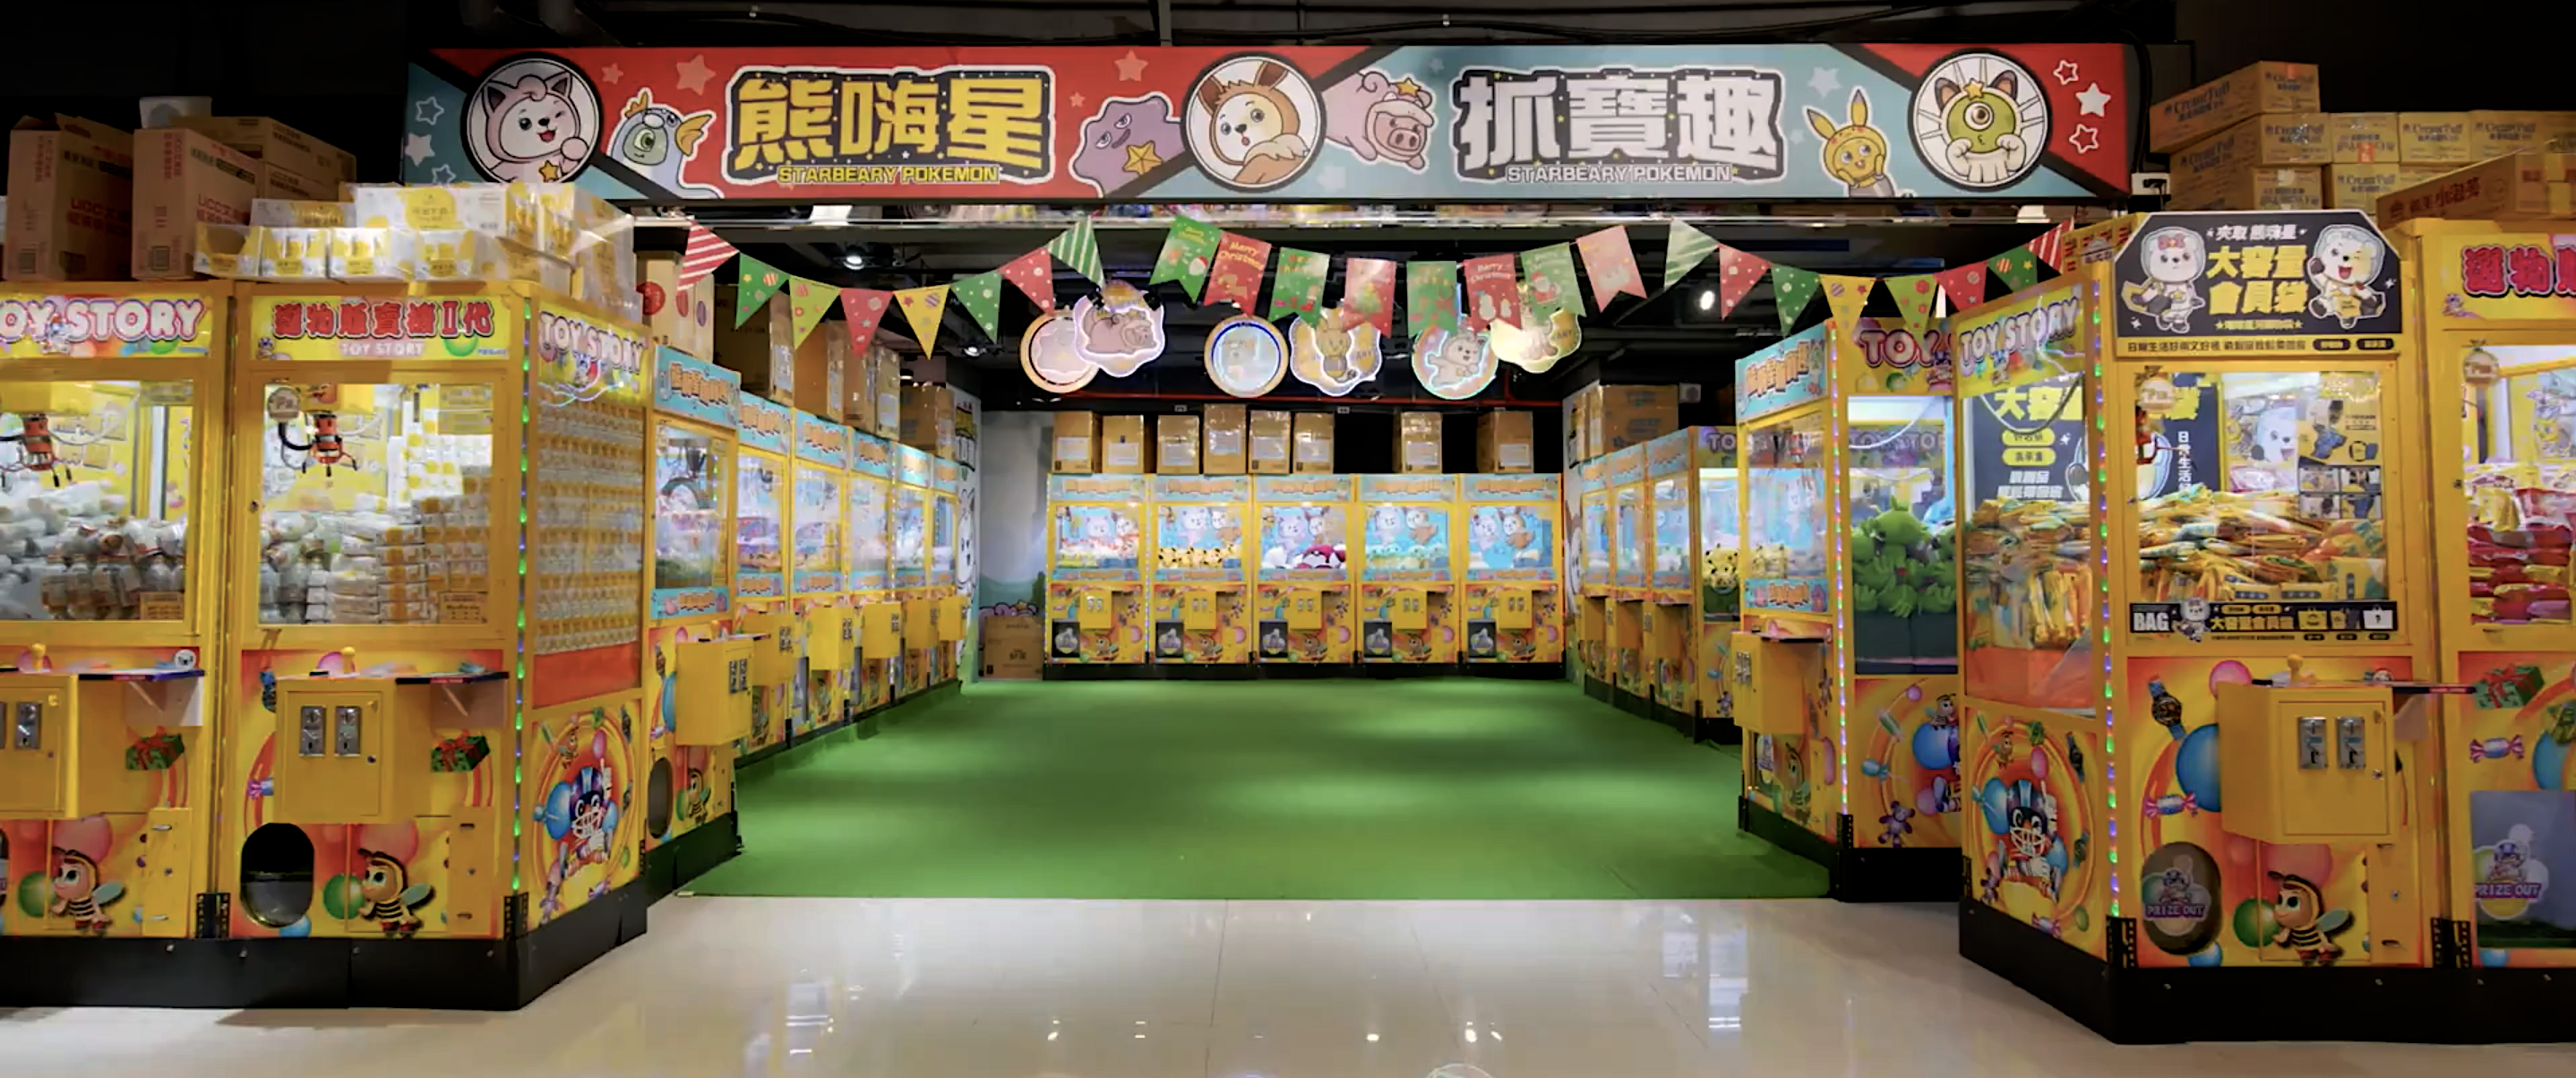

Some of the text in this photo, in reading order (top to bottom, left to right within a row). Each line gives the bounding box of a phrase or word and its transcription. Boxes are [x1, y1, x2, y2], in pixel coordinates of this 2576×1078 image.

[734, 78, 1043, 170] 熊嗨星
[1459, 74, 1777, 170] 抓寶趣
[777, 166, 999, 183] STARBEARY POKEMON
[1506, 165, 1733, 183] STARBEARY POKEMON
[1230, 241, 1260, 256] Merry
[1218, 250, 1265, 272] Christmas
[66, 299, 204, 342] STORY
[539, 311, 584, 357] TOY
[1959, 296, 2080, 365] TOY STORY
[339, 342, 425, 356] TOY STORY
[2133, 612, 2170, 631] BAG
[2474, 884, 2541, 896] PRIZE OUT
[2147, 904, 2204, 917] PRIZE OUT
